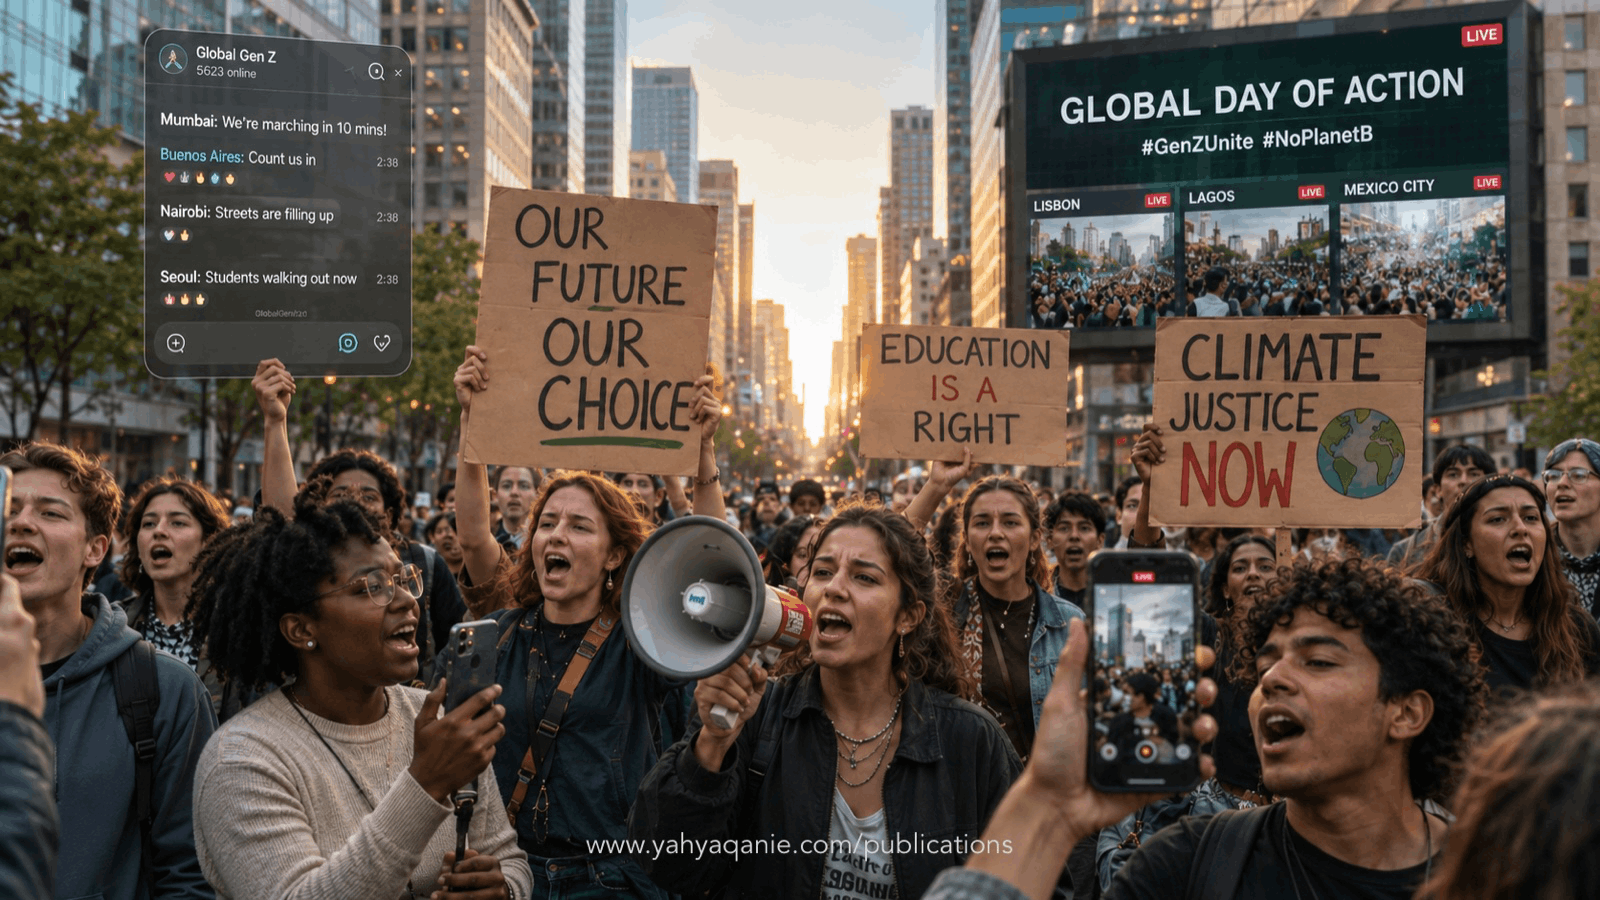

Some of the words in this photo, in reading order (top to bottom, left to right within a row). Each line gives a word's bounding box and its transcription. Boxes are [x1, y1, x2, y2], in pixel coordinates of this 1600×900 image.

[1466, 28, 1498, 42] LIVE
[196, 46, 236, 61] Global
[240, 49, 265, 62] Gen
[267, 51, 277, 63] Z
[196, 65, 224, 77] 5623
[227, 67, 257, 78] online
[1060, 88, 1202, 125] GLOBAL
[1214, 81, 1282, 114] DAY
[1292, 77, 1335, 108] OF
[1344, 67, 1464, 105] ACTION
[160, 112, 218, 128] Mumbai:
[222, 115, 259, 130] We're
[262, 119, 320, 136] marching
[322, 120, 334, 134] in
[336, 122, 352, 135] 10
[355, 123, 387, 137] mins!
[1141, 132, 1254, 156] #GenZUnite
[1262, 125, 1374, 148] #NoPlanetB
[160, 147, 207, 162] Buenos
[209, 149, 245, 163] Aires:
[248, 150, 286, 165] Count
[288, 154, 303, 165] us
[305, 152, 316, 166] in
[376, 156, 399, 168] 2:38
[1301, 187, 1323, 197] LIVE
[1344, 180, 1399, 196] MEXICO
[1402, 178, 1435, 193] CITY
[1477, 178, 1499, 187] LIVE
[1034, 198, 1080, 212] LISBON
[1147, 195, 1168, 205] LIVE
[1189, 190, 1235, 205] LAGOS
[160, 204, 211, 219] Nairobi:
[215, 206, 259, 220] Streets
[262, 209, 282, 221] are
[285, 207, 316, 225] filling
[318, 211, 335, 226] up
[376, 211, 399, 223] 2:38
[515, 203, 609, 250] OUR
[160, 270, 201, 284] Seoul:
[205, 270, 260, 284] Students
[262, 271, 308, 288] walking
[310, 273, 331, 285] out
[333, 275, 358, 285] now
[376, 273, 399, 285] 2:38
[531, 261, 688, 306] FUTURE
[542, 317, 650, 368] OUR
[880, 333, 1051, 370] EDUCATION
[1181, 332, 1382, 382] CLIMATE
[931, 374, 960, 401] IS
[976, 376, 998, 403] A
[537, 374, 695, 432] CHOICE
[1169, 392, 1319, 432] JUSTICE
[914, 410, 1021, 445] RIGHT
[1179, 440, 1297, 508] NOW
